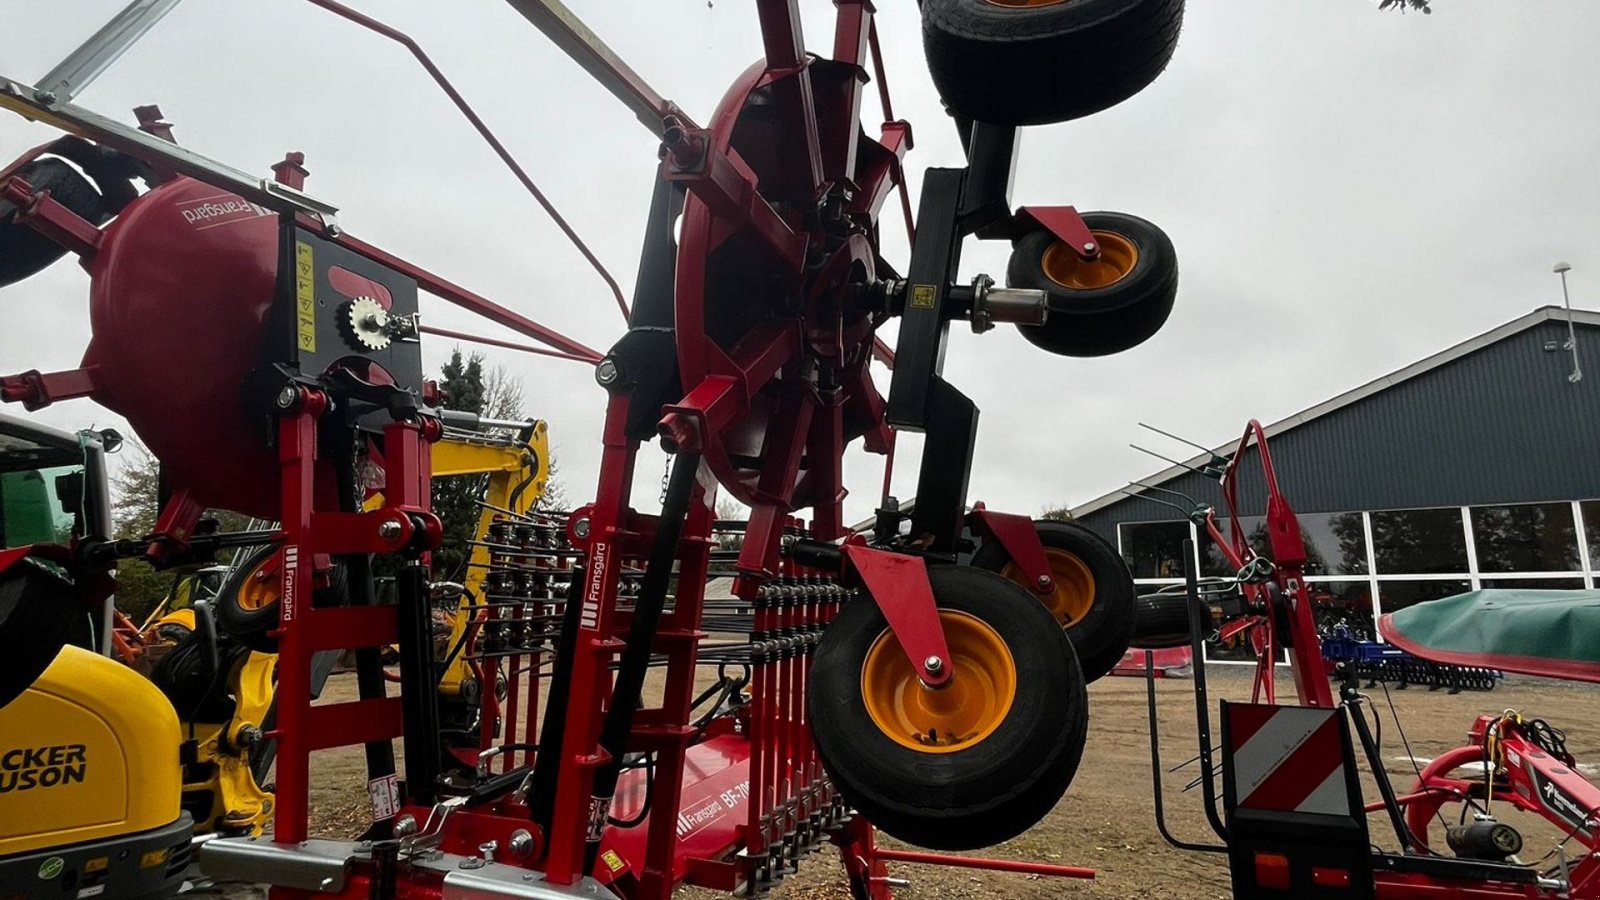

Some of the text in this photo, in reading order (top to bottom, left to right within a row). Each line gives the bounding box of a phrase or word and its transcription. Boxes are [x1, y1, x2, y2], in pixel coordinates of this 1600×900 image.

[181, 199, 252, 224] Fransgård
[283, 569, 294, 621] Fransgård
[589, 542, 606, 601] Fransgård
